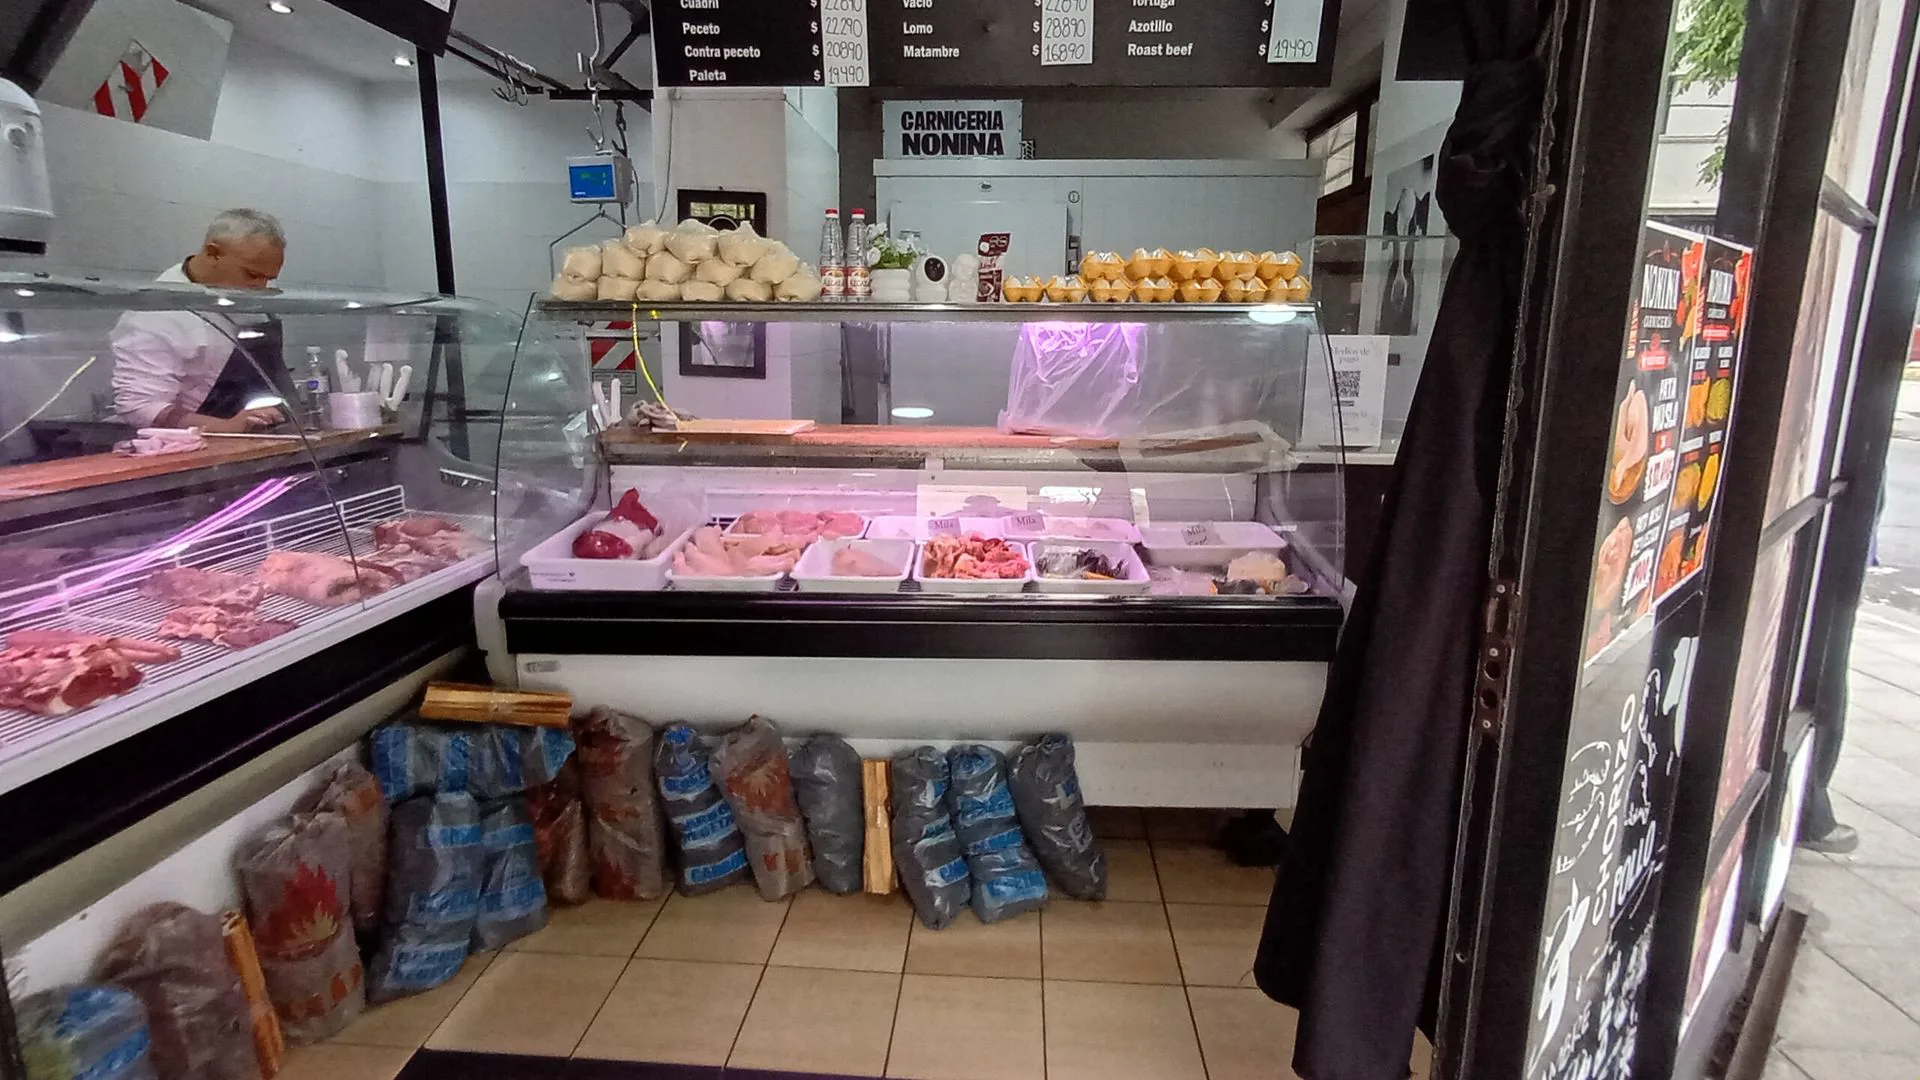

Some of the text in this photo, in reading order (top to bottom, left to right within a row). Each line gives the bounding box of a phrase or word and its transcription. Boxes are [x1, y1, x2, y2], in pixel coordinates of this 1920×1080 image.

[682, 16, 863, 38] Peceto $ 22290
[903, 17, 1086, 39] Lomo $ 28890
[1260, 19, 1269, 33] $
[684, 41, 863, 61] Contra peceto $ 20890
[903, 42, 1085, 62] Matambre $ 16890
[1127, 39, 1314, 59] Roast beef $ 19490
[688, 65, 864, 84] Paleta $ 19490
[901, 110, 1004, 131] CARNICERIA
[902, 133, 1004, 155] NONINA
[1609, 819, 1657, 920] POLLO
